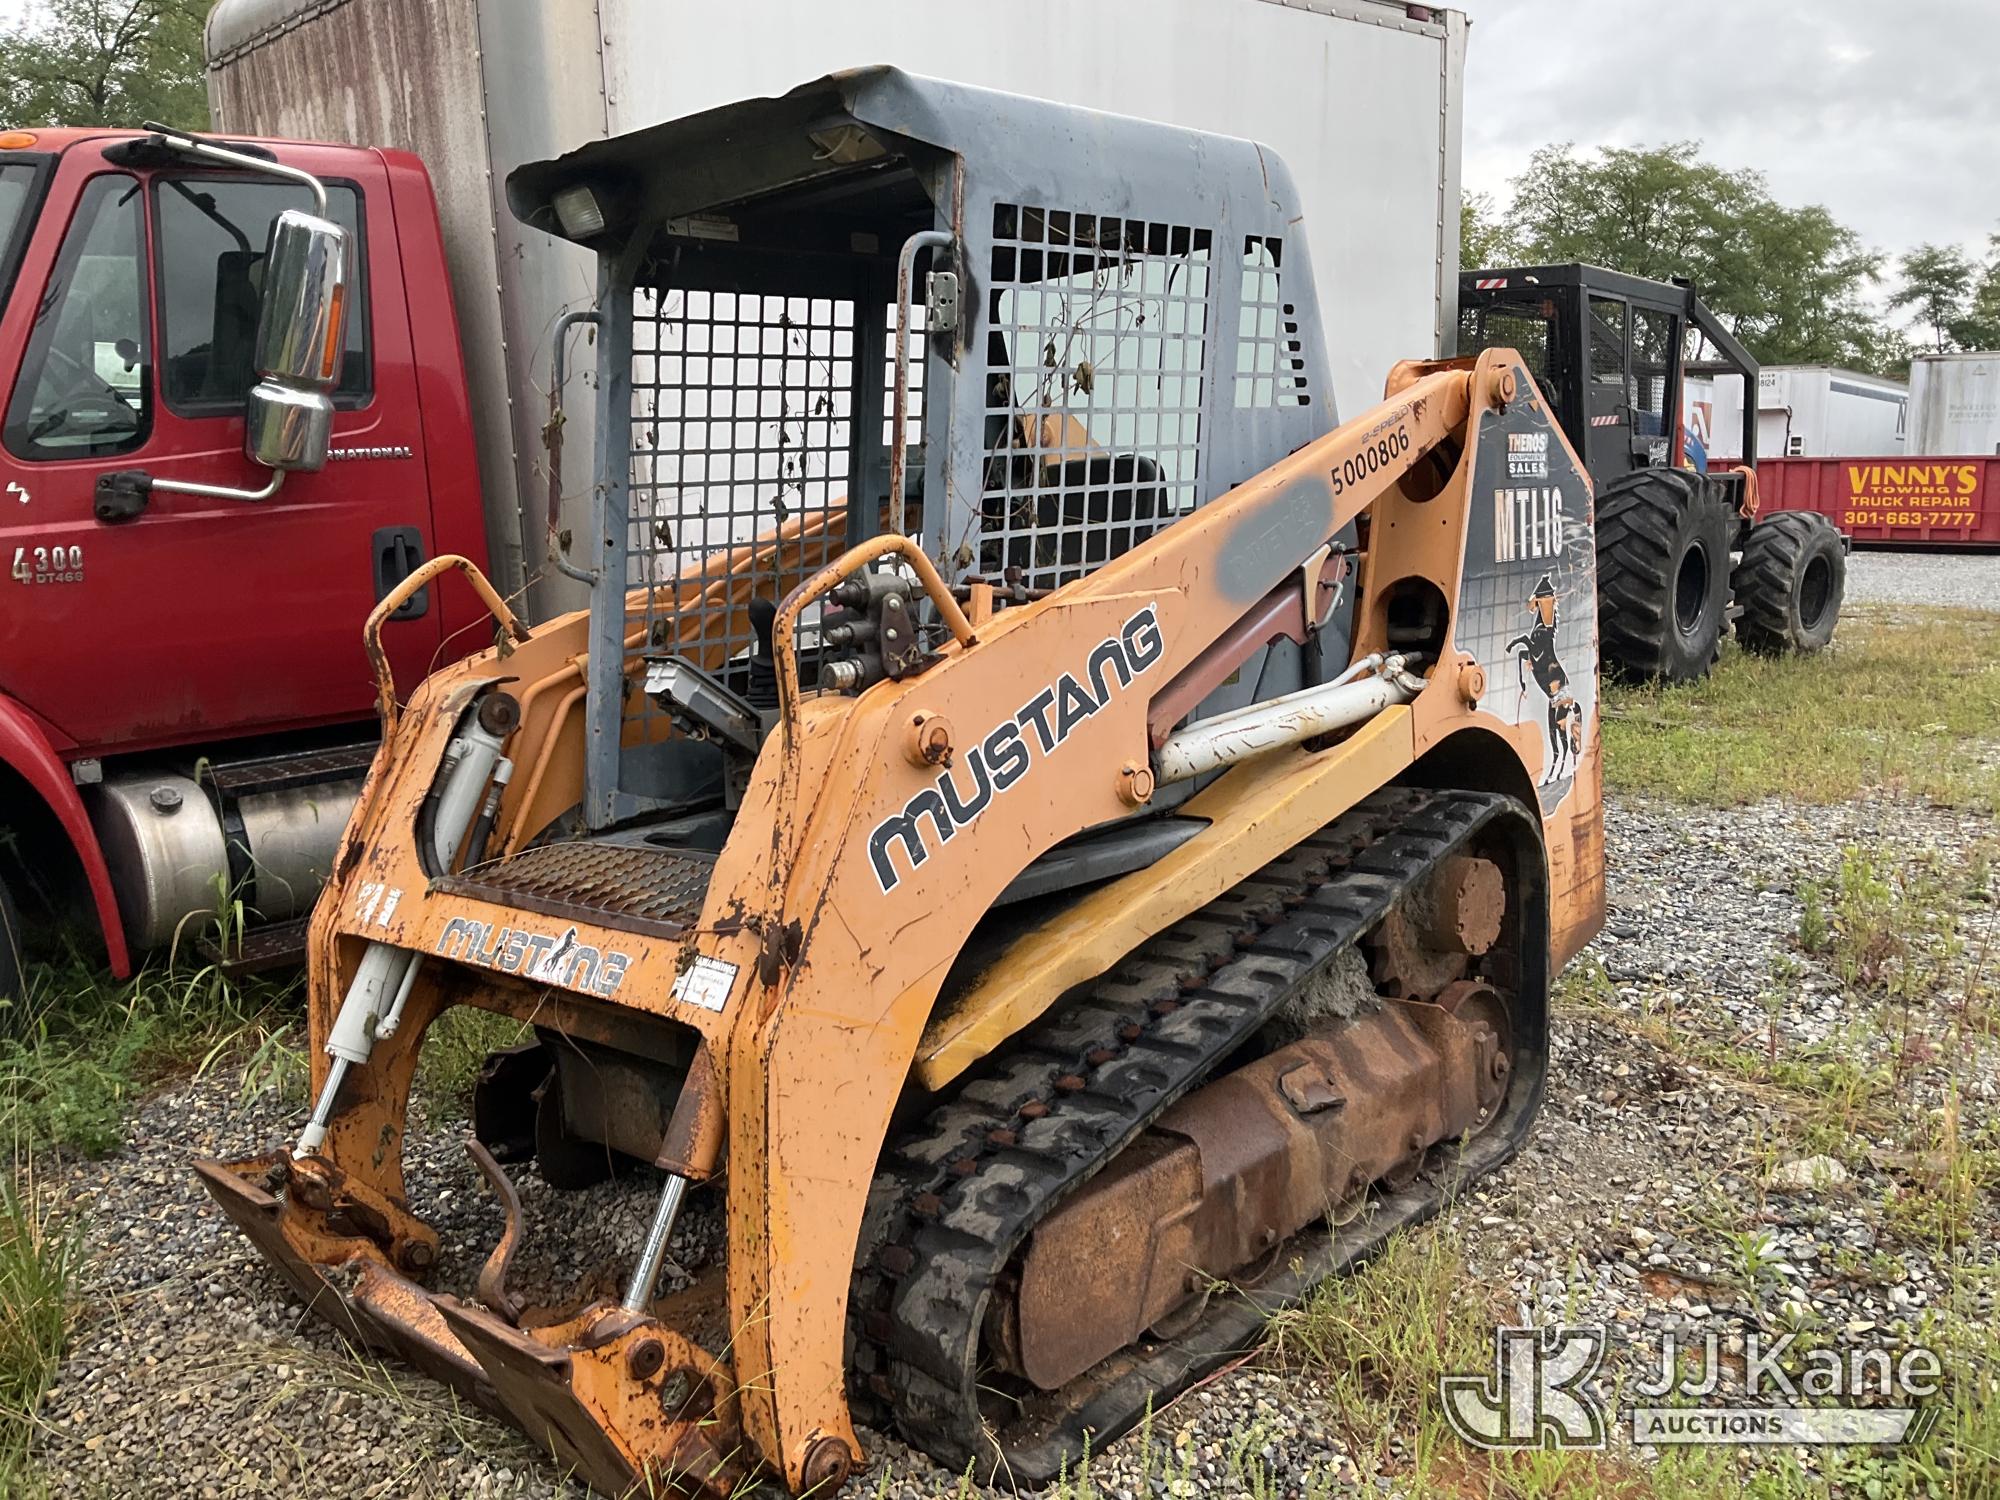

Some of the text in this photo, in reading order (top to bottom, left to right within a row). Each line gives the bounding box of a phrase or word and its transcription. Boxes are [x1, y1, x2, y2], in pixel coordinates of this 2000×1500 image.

[1508, 433, 1547, 452] THEROS
[1330, 424, 1409, 496] 5000806
[1509, 462, 1545, 474] SALES
[1848, 465, 1977, 494] VINNY'S
[1871, 486, 1950, 494] TOWING
[1850, 496, 1971, 507] TRUCK REPAIR
[1494, 486, 1563, 563] MTL16
[1844, 511, 1976, 526] 301-663-7777
[11, 545, 84, 585] 4300
[36, 571, 84, 584] DT466
[867, 601, 1164, 895] MUSTANG
[436, 916, 634, 997] MUSTANG
